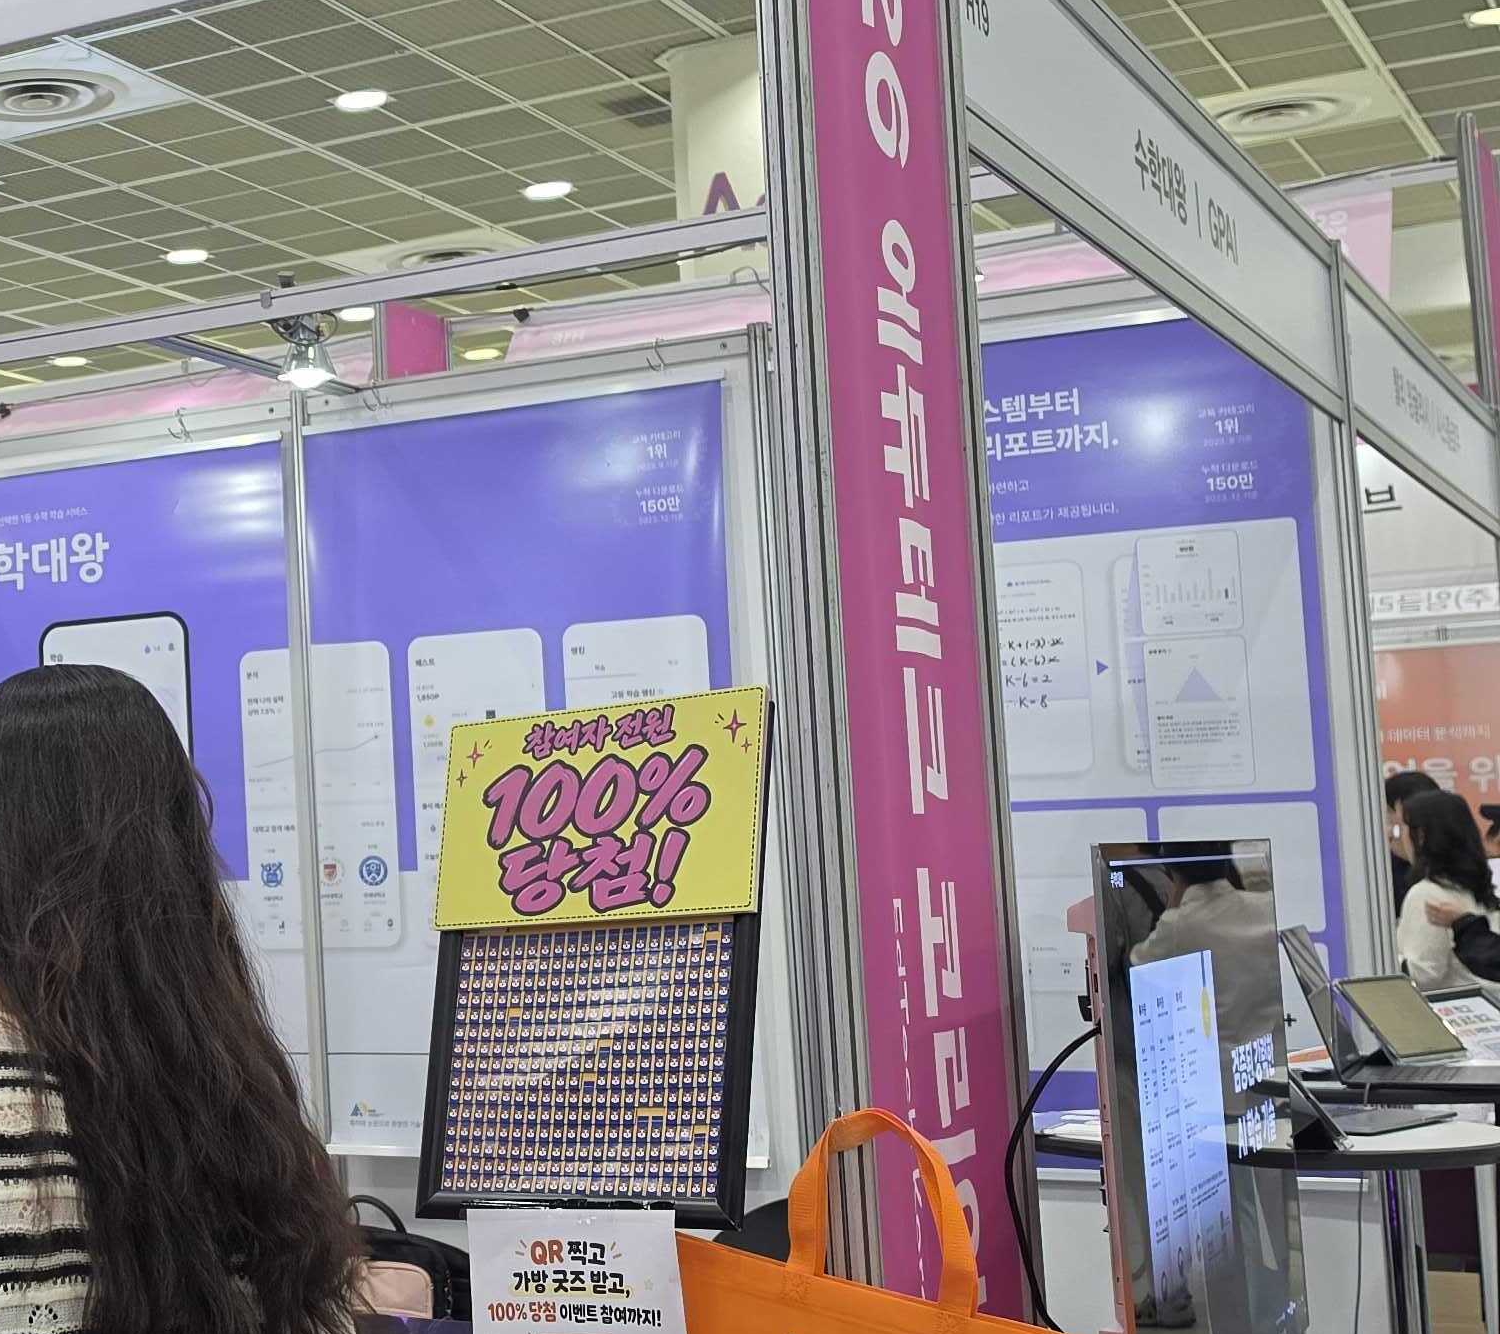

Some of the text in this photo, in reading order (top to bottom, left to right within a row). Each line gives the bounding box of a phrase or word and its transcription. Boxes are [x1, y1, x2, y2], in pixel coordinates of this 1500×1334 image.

[1134, 128, 1189, 227] 수학대왕
[1207, 198, 1240, 265] GPAI
[1215, 416, 1239, 435] 1위
[647, 442, 667, 460] 1위
[1206, 472, 1254, 492] 150만
[640, 495, 681, 514] 150만
[877, 218, 951, 817] 에듀테크
[522, 703, 676, 762] 참여자 전원
[482, 743, 711, 850] 100%
[498, 825, 691, 916] 당첨!
[531, 1239, 606, 1266] QR 찍고
[512, 1269, 631, 1298] 가방 굿즈 받고,
[487, 1301, 662, 1328] 100% 당첨 이벤트 참여까지!
